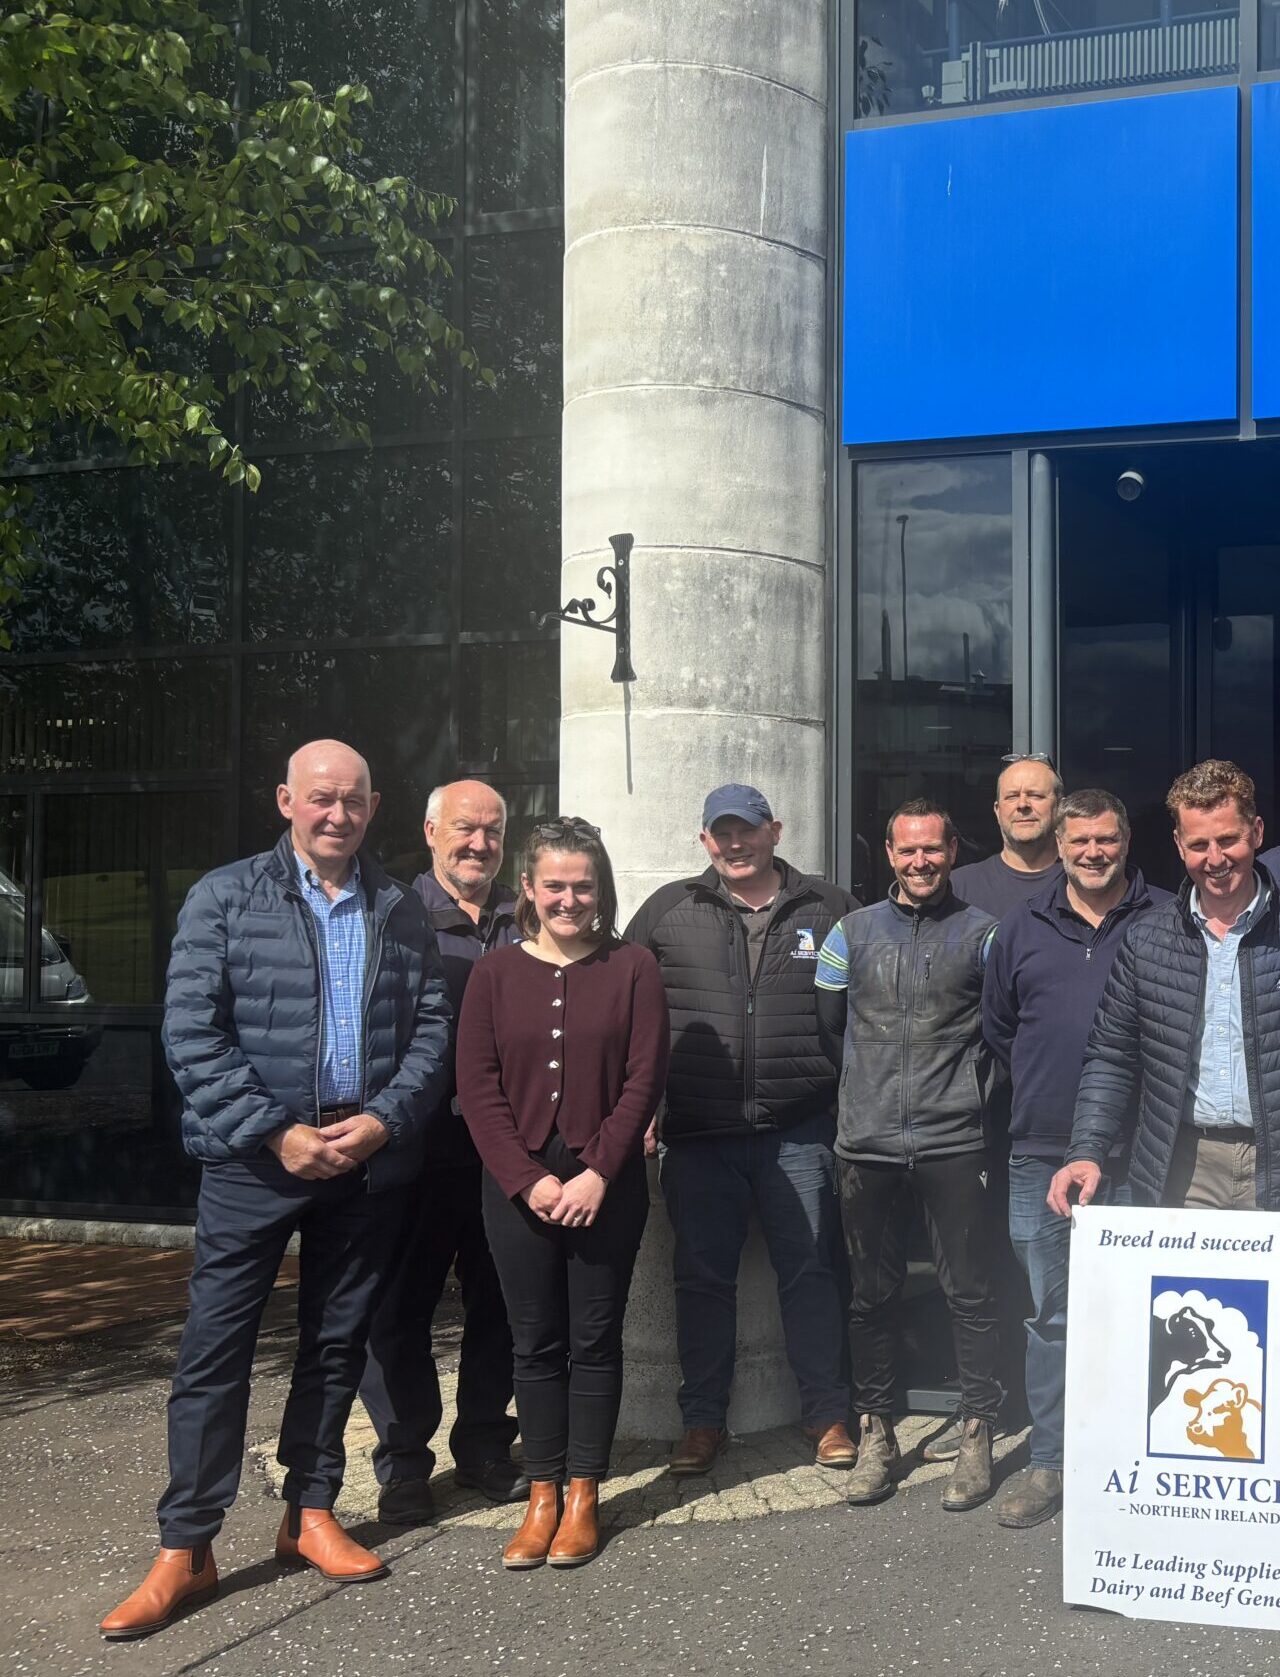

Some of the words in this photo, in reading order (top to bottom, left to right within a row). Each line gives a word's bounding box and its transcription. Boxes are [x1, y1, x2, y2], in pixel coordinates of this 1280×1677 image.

[1098, 1229, 1154, 1248] Breed
[1158, 1231, 1197, 1250] and
[1200, 1234, 1274, 1253] succeed
[1103, 1460, 1140, 1495] Ai
[1129, 1503, 1211, 1520] NORTHERN
[1215, 1509, 1280, 1524] IRELAND
[1094, 1550, 1127, 1569] The
[1131, 1553, 1208, 1580] Leading
[1090, 1577, 1146, 1602] Dairy
[1149, 1583, 1186, 1600] and
[1190, 1585, 1235, 1609] Beef
